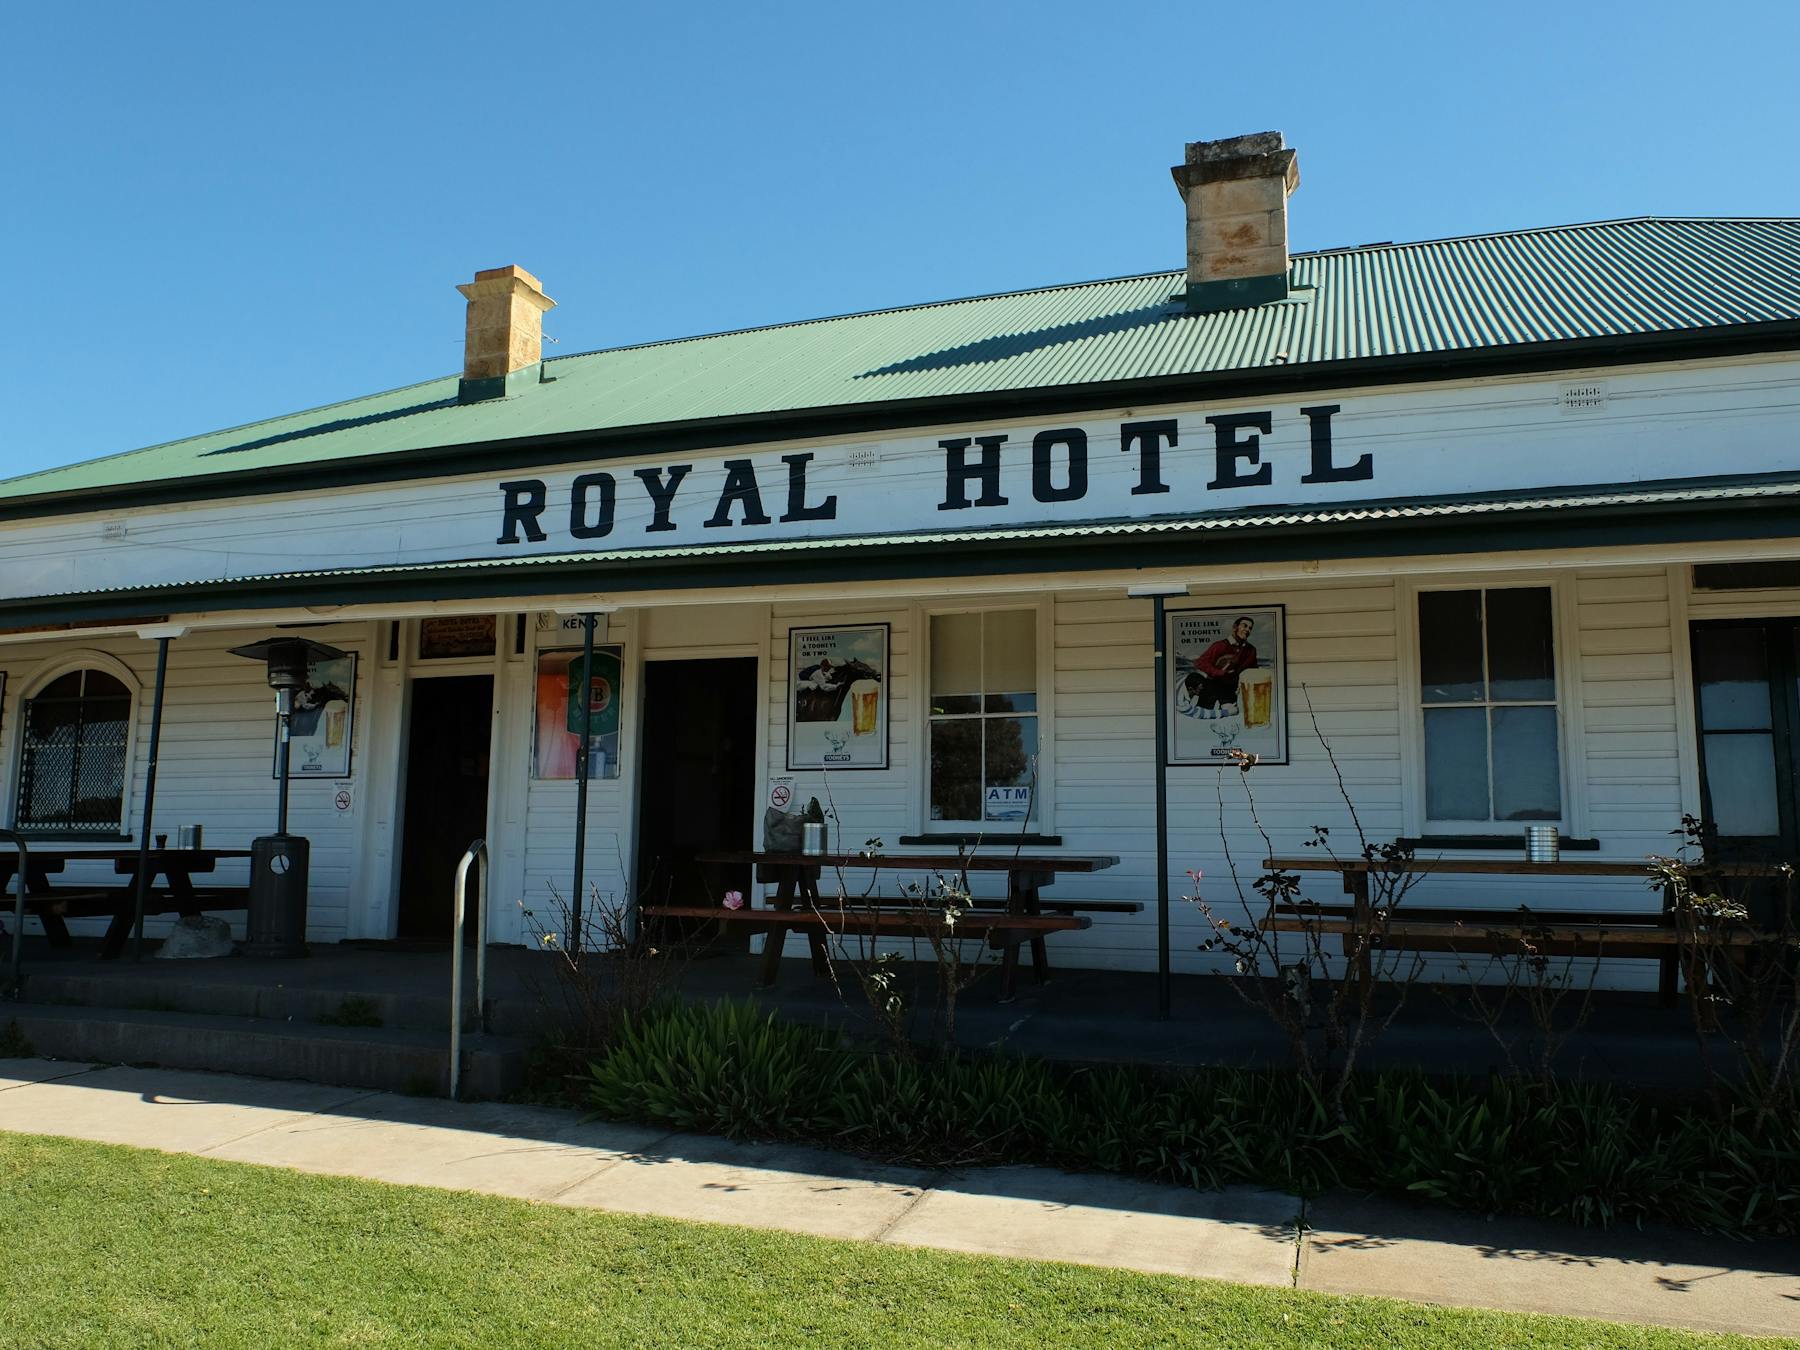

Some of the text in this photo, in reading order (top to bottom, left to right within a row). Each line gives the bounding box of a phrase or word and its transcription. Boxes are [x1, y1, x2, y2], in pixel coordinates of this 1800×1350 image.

[497, 405, 1373, 544] ROYAL HOTEL
[988, 788, 1027, 800] ATM
